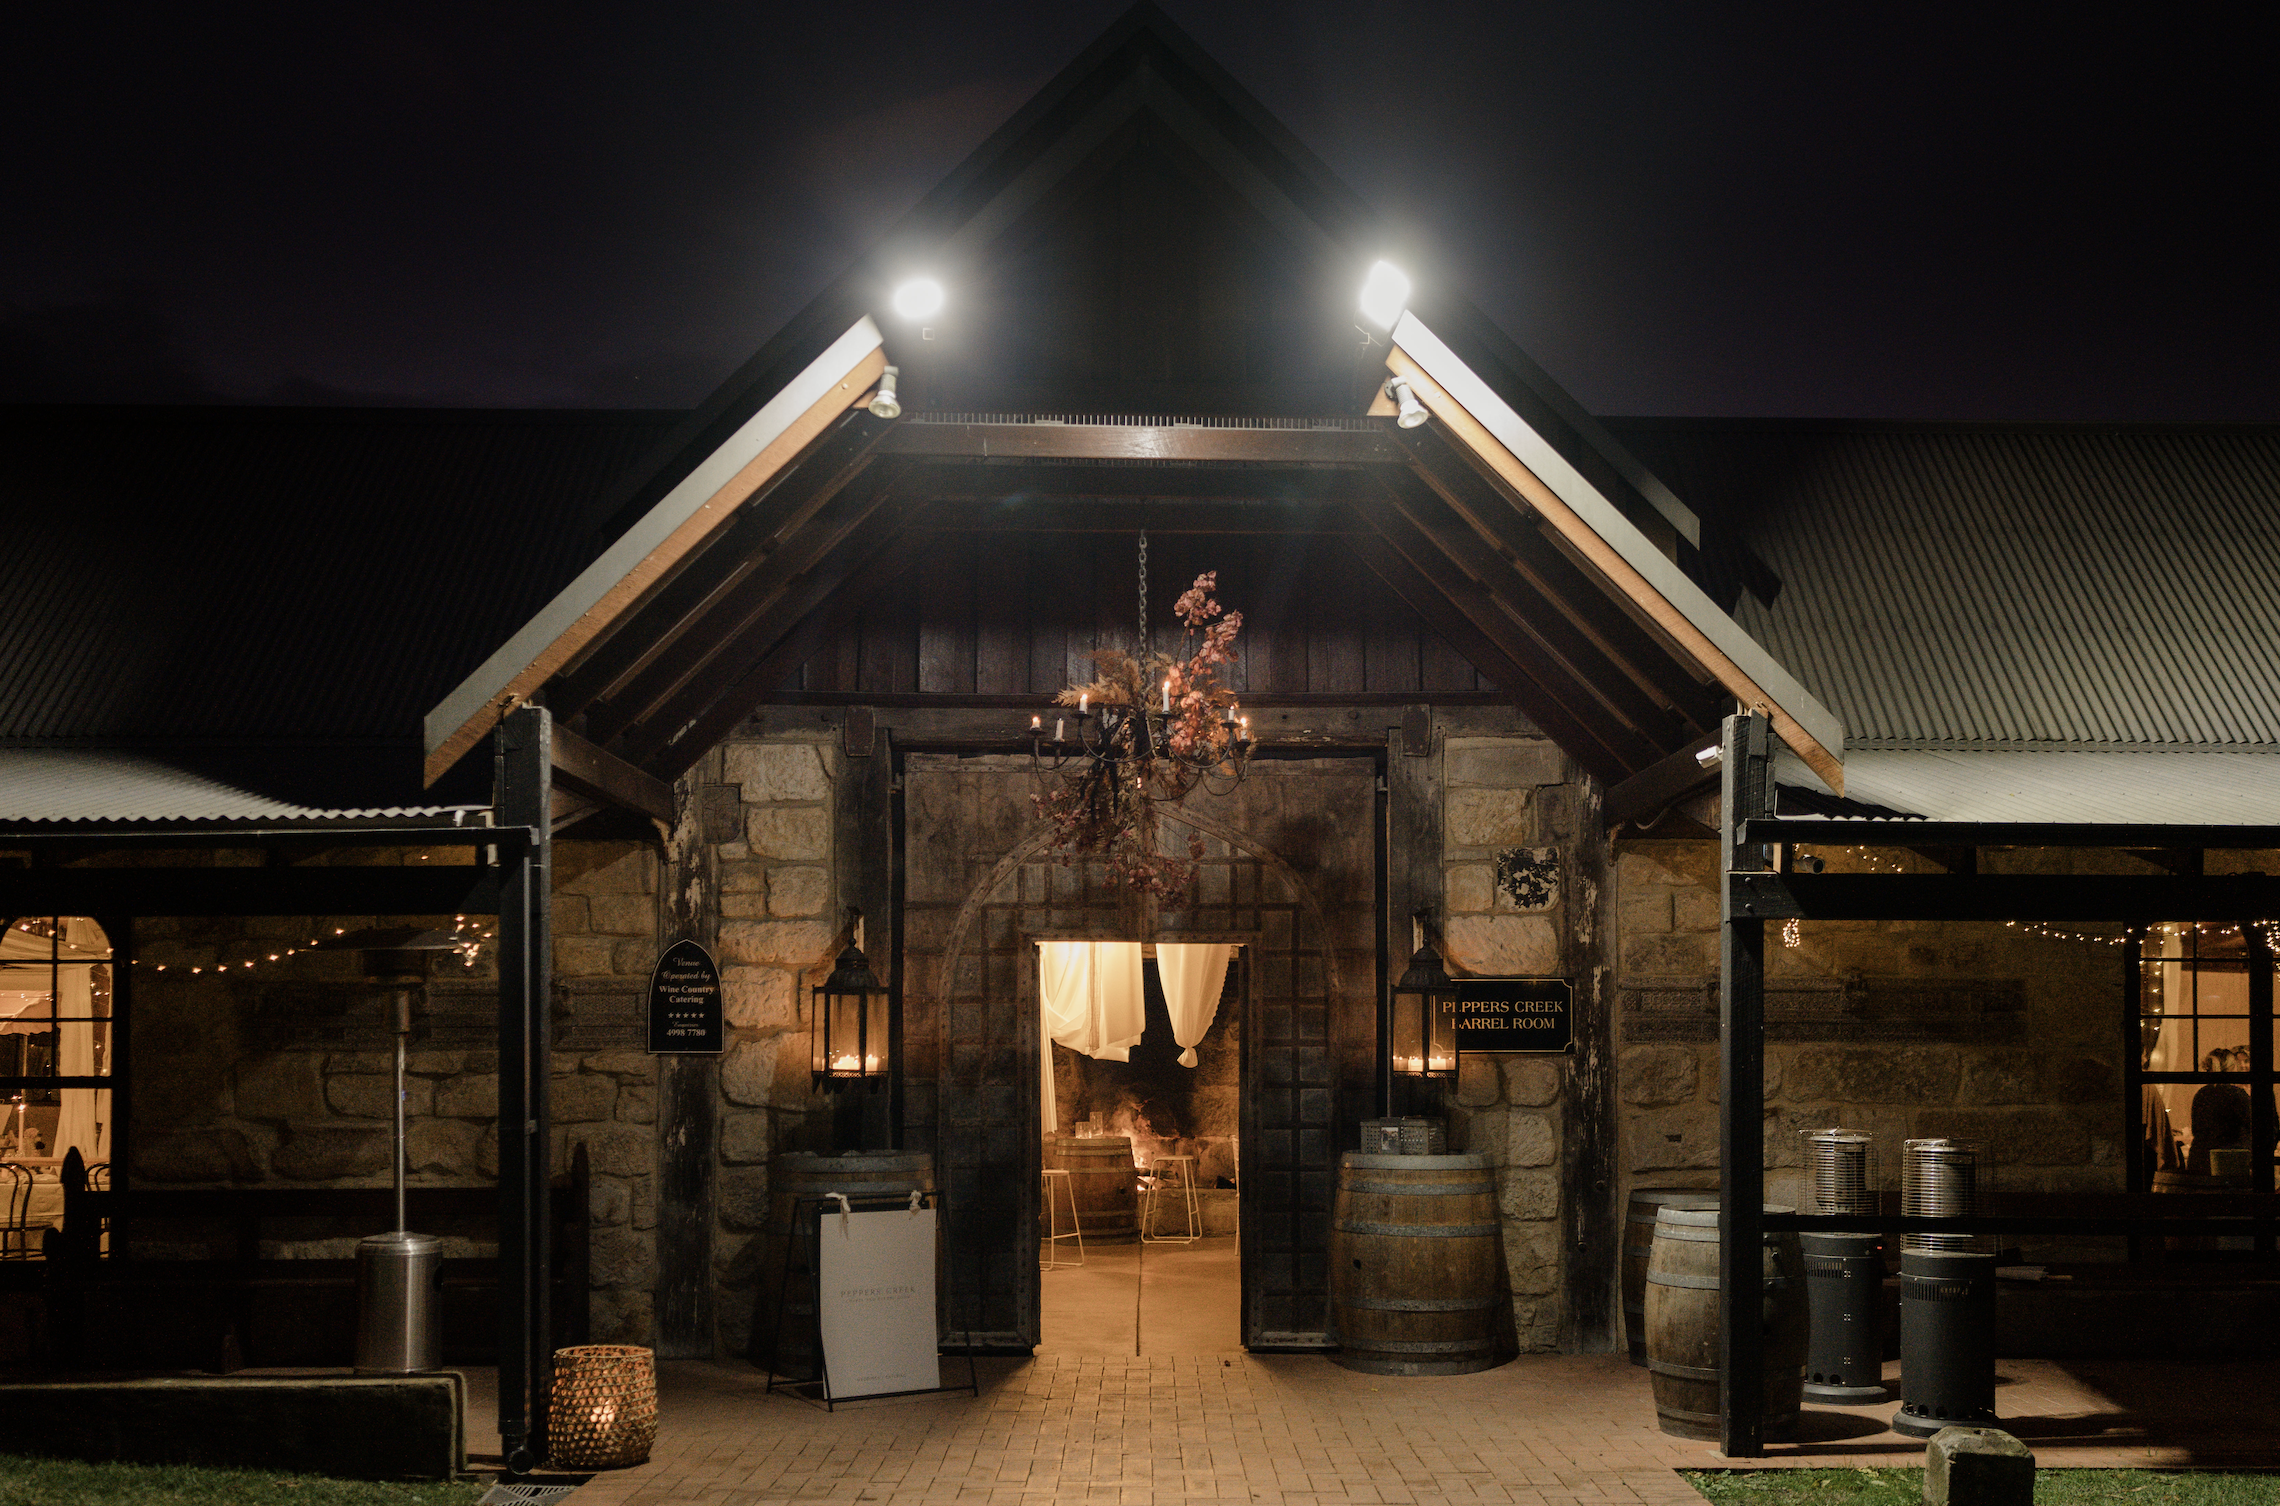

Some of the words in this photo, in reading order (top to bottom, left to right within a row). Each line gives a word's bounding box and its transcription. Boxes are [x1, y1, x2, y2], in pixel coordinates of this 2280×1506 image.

[672, 957, 700, 967] Venue
[661, 970, 699, 982] Operated
[701, 970, 711, 982] by
[658, 985, 680, 993] Wine
[681, 985, 714, 995] Country
[668, 995, 704, 1005] Catering
[1514, 1000, 1563, 1013] CREEK
[1512, 1017, 1555, 1030] ROOM
[666, 1028, 686, 1037] 4998
[687, 1028, 706, 1037] 7780
[885, 1286, 915, 1294] CREEK
